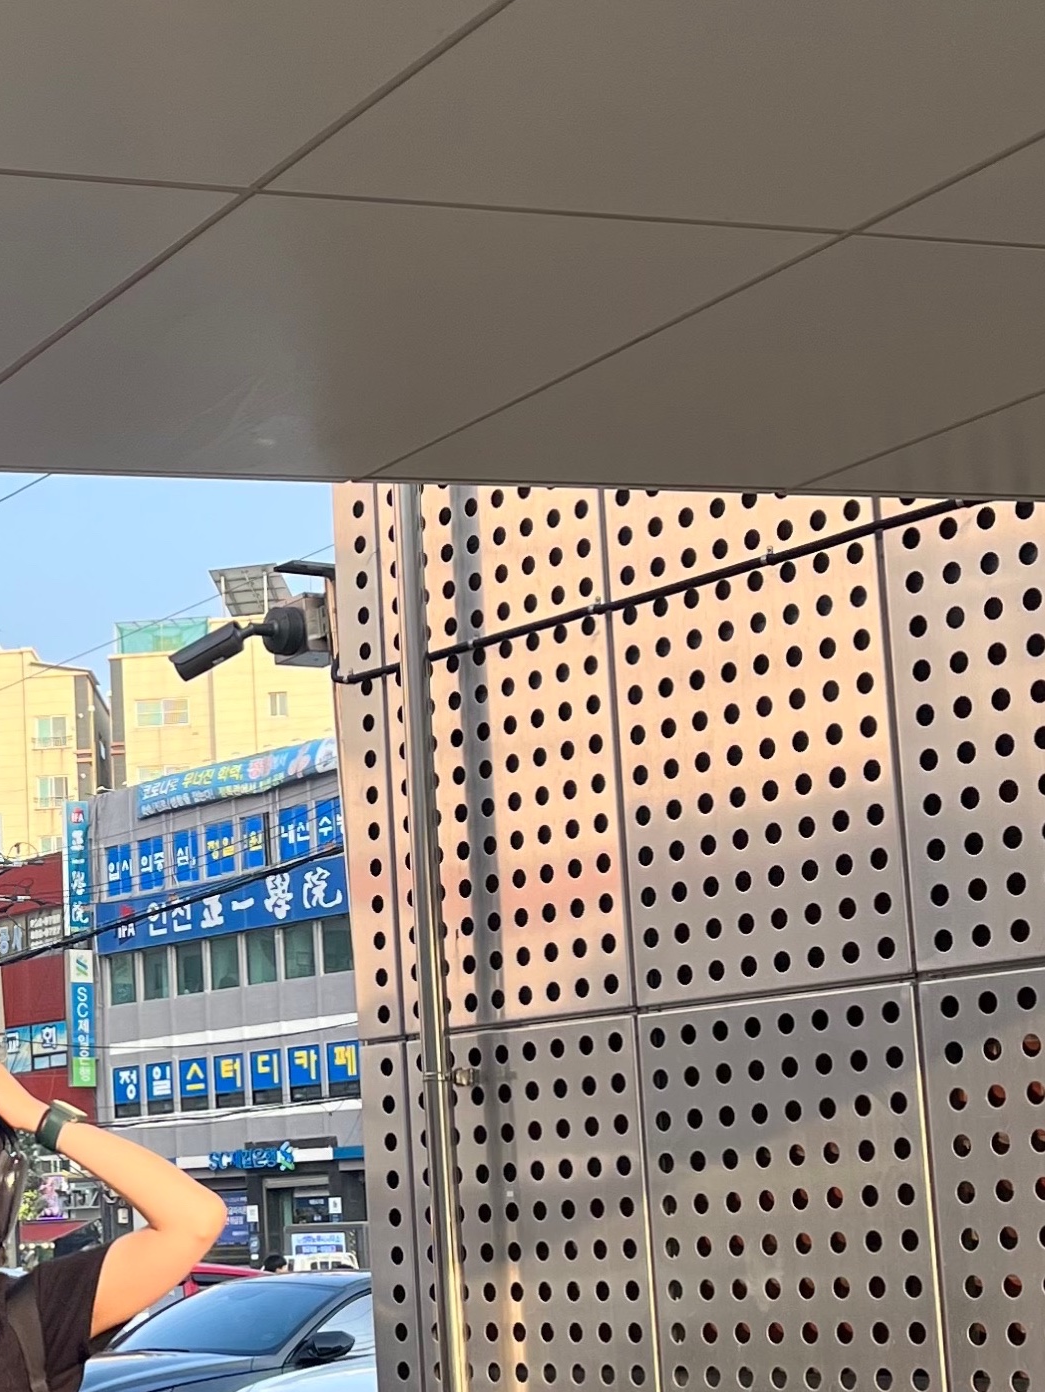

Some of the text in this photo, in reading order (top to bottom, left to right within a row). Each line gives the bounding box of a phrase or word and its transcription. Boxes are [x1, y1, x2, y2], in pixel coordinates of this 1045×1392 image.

[142, 779, 178, 800] 코로나로
[182, 769, 215, 789] 무너진
[207, 830, 263, 861] 정일원
[76, 986, 90, 1082] SC제일은행
